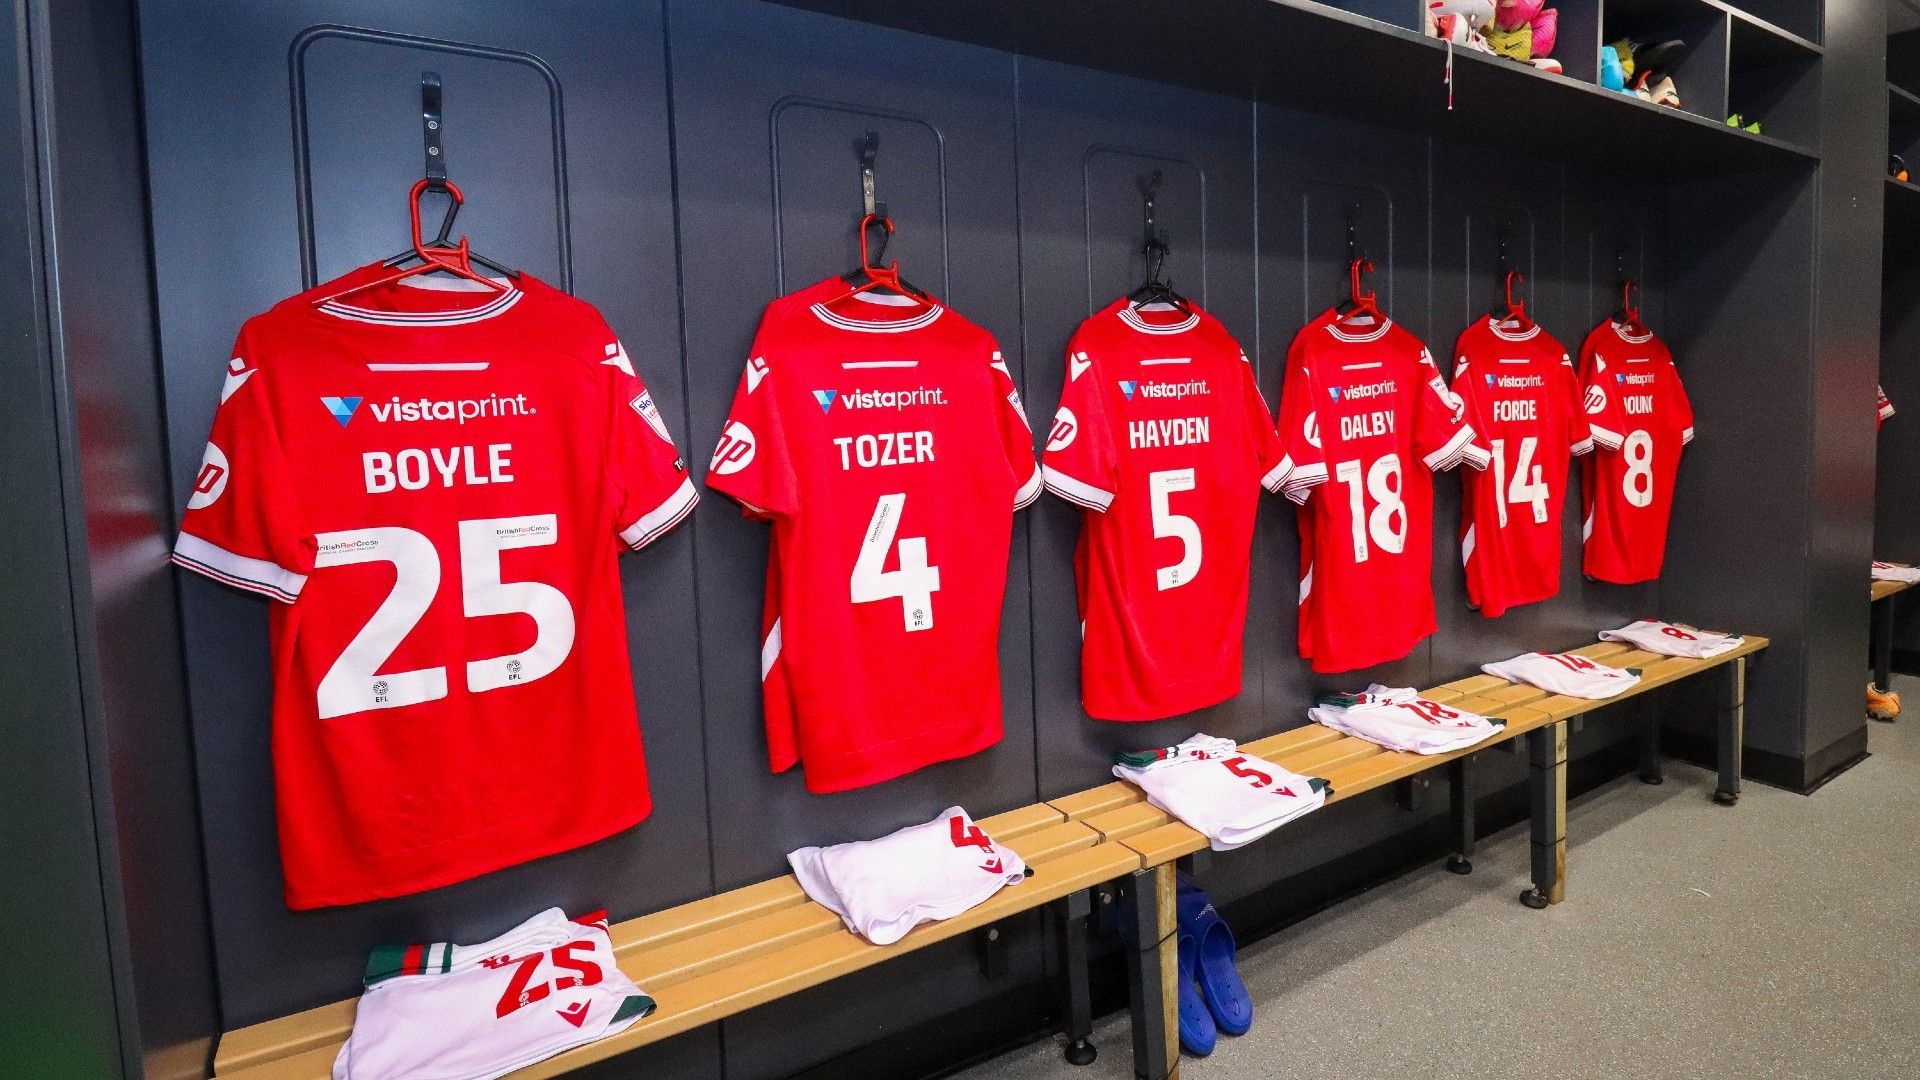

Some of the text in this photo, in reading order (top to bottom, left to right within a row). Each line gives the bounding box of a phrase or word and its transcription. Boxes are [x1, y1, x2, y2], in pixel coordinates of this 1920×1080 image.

[1129, 416, 1210, 449] HAYDEN
[1341, 410, 1394, 441] DALBY
[1494, 399, 1537, 422] FORDE
[363, 443, 514, 494] BOYLE
[833, 430, 935, 471] TOZER
[1622, 429, 1653, 508] 8
[1336, 453, 1408, 564] 18
[1491, 437, 1549, 529] 14
[1149, 468, 1203, 592] 5
[851, 492, 941, 632] 4
[313, 513, 576, 720] 25
[1660, 627, 1697, 641] 8
[1221, 756, 1273, 788] 5
[950, 815, 995, 854] 4
[491, 940, 603, 1019] 25
